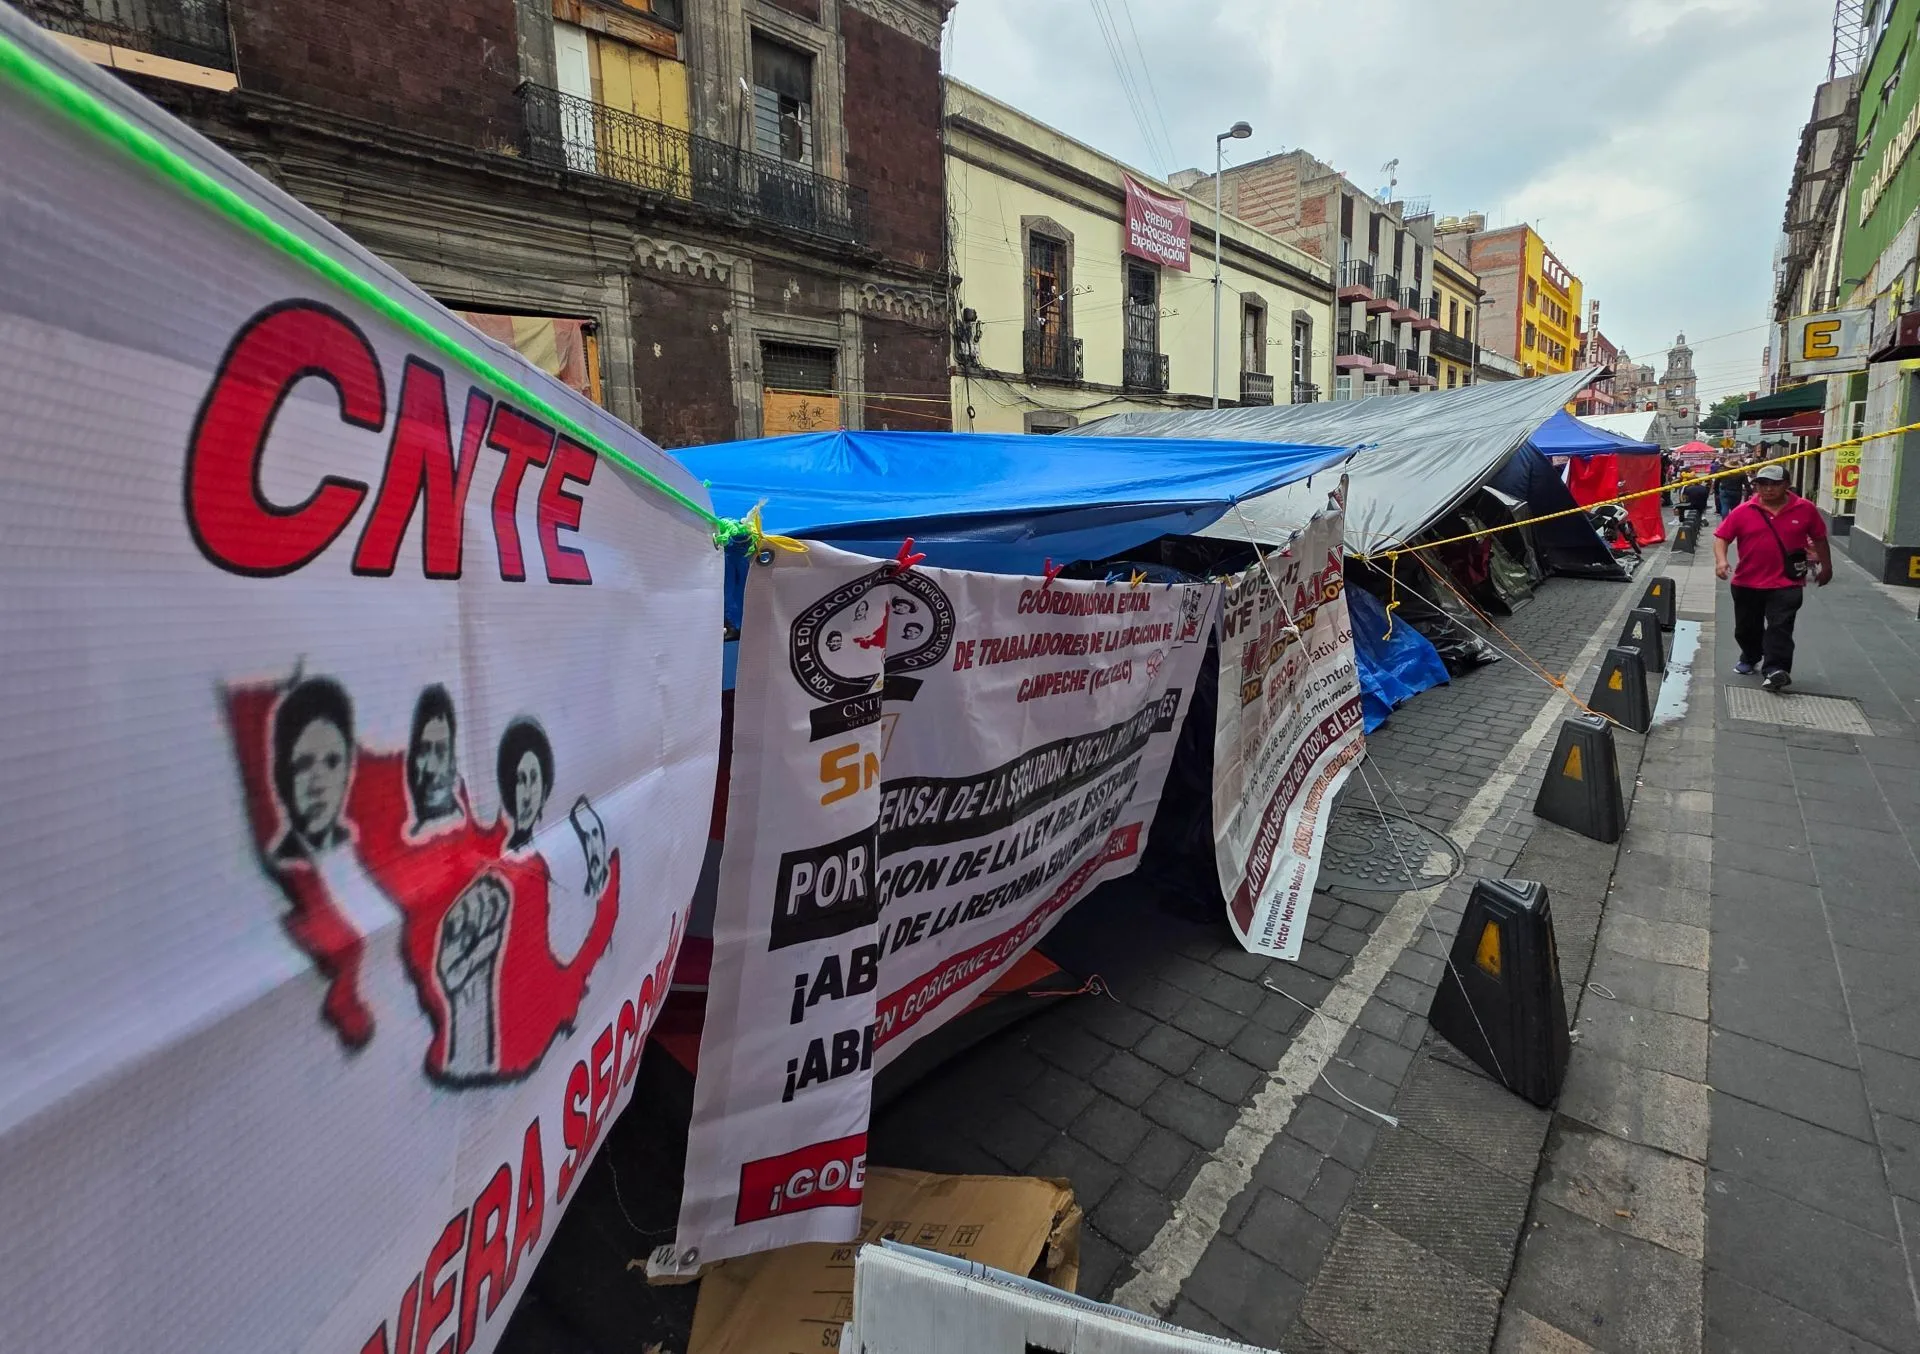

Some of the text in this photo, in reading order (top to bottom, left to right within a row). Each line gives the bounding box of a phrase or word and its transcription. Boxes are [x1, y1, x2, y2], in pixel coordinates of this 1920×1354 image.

[1131, 217, 1186, 249] EN PROCESO DE
[1145, 210, 1173, 231] PREDIO
[1131, 233, 1185, 263] EXPROPIACIÓN
[1589, 300, 1600, 364] HOTEL
[1803, 319, 1842, 360] E
[184, 297, 598, 587] CNTE
[797, 569, 951, 694] POR LA EDUCACION AL SERVICIO DEL PUEBLO
[953, 639, 976, 672] DE
[979, 631, 1090, 667] TRABAJADORES
[1089, 632, 1104, 655] DE
[1105, 631, 1121, 653] LA
[1016, 669, 1091, 704] CAMPECHE
[1313, 661, 1353, 692] control
[944, 781, 984, 822] DE
[983, 773, 1008, 816] LA
[1270, 777, 1296, 824] salarial
[1293, 757, 1307, 785] del
[1302, 727, 1329, 765] 100%
[945, 845, 993, 888] DE
[988, 834, 1021, 874] LA
[1020, 815, 1052, 861] LEY
[786, 842, 869, 919] POR
[890, 909, 931, 955] DE
[929, 900, 963, 937] LA
[960, 865, 1045, 924] REFORMA
[1258, 889, 1285, 948] In memoriam:
[1280, 892, 1298, 924] Moreno
[1273, 922, 1289, 951] Víctor
[901, 948, 992, 1022] GOBIERNE
